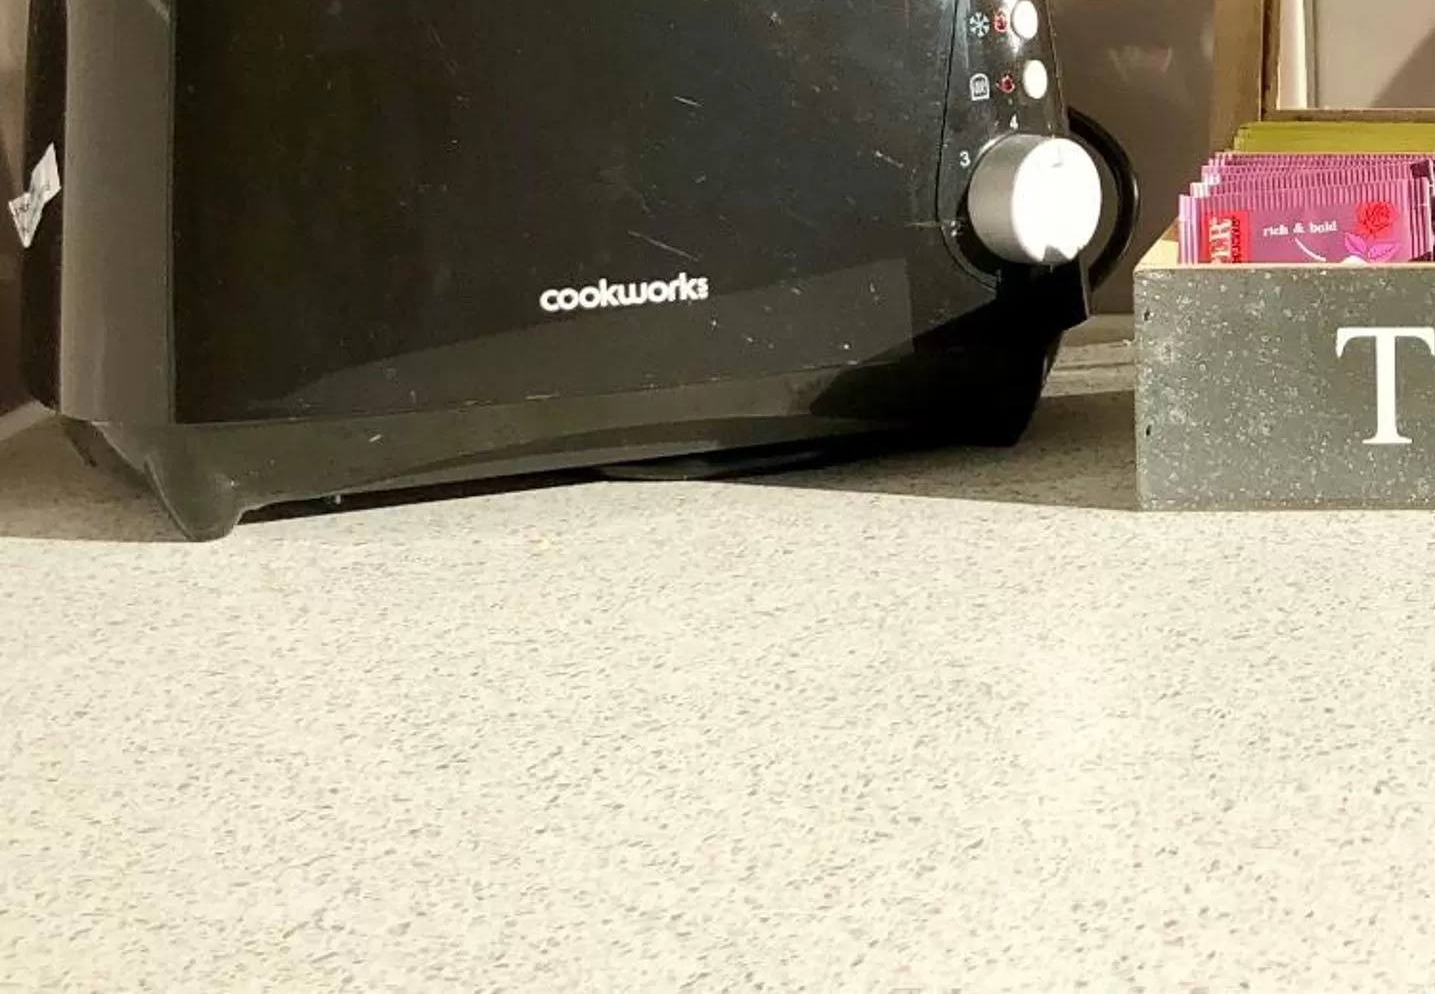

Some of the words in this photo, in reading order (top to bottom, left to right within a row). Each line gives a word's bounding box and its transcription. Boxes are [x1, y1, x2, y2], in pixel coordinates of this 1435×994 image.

[1010, 114, 1018, 130] 4
[960, 150, 971, 167] 3
[1263, 224, 1289, 237] rich
[1293, 222, 1305, 233] &
[1309, 220, 1337, 234] bold
[539, 271, 709, 312] cookworks
